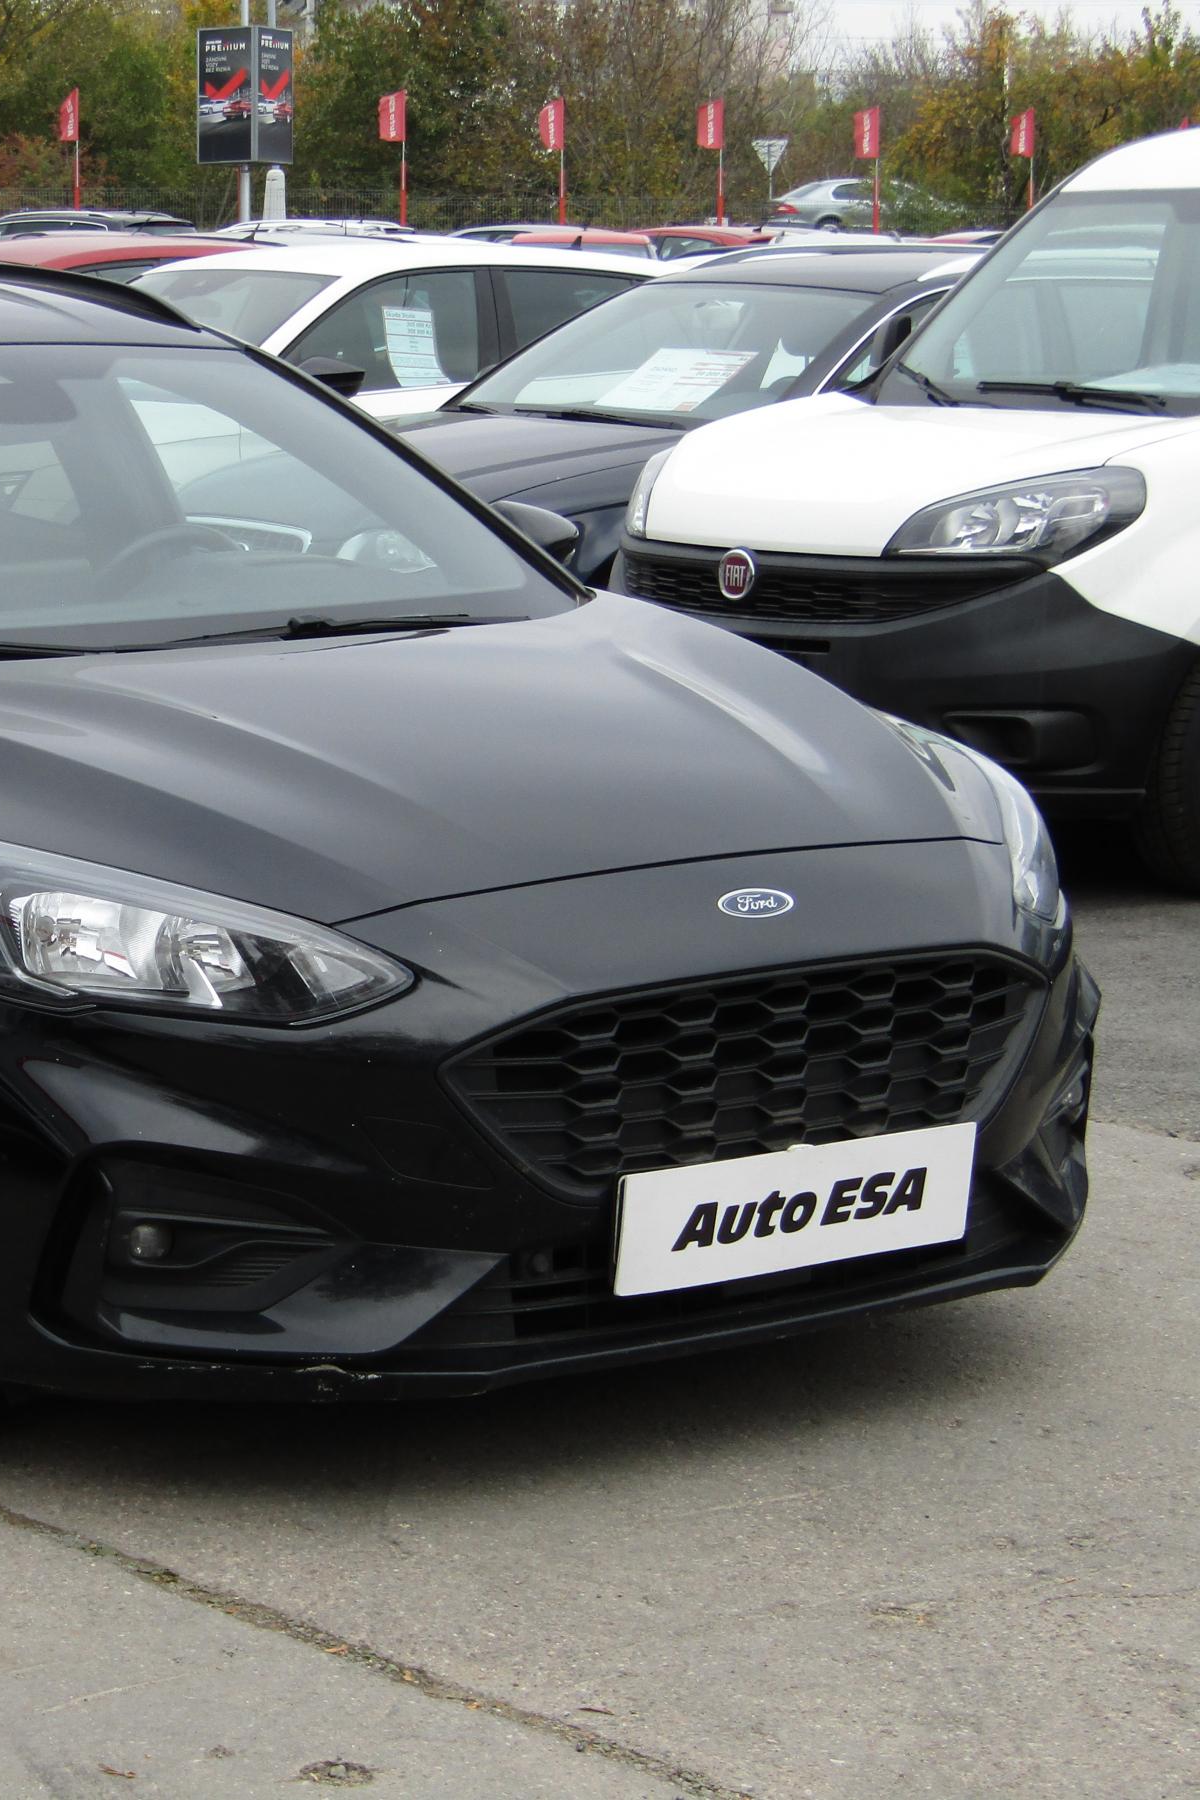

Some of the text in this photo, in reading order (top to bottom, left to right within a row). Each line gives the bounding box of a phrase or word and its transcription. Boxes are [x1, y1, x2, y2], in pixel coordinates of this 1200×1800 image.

[206, 43, 246, 52] PREMIUM
[725, 564, 746, 587] FIAT
[737, 894, 778, 911] Ford
[671, 1166, 927, 1252] Auto ESA
